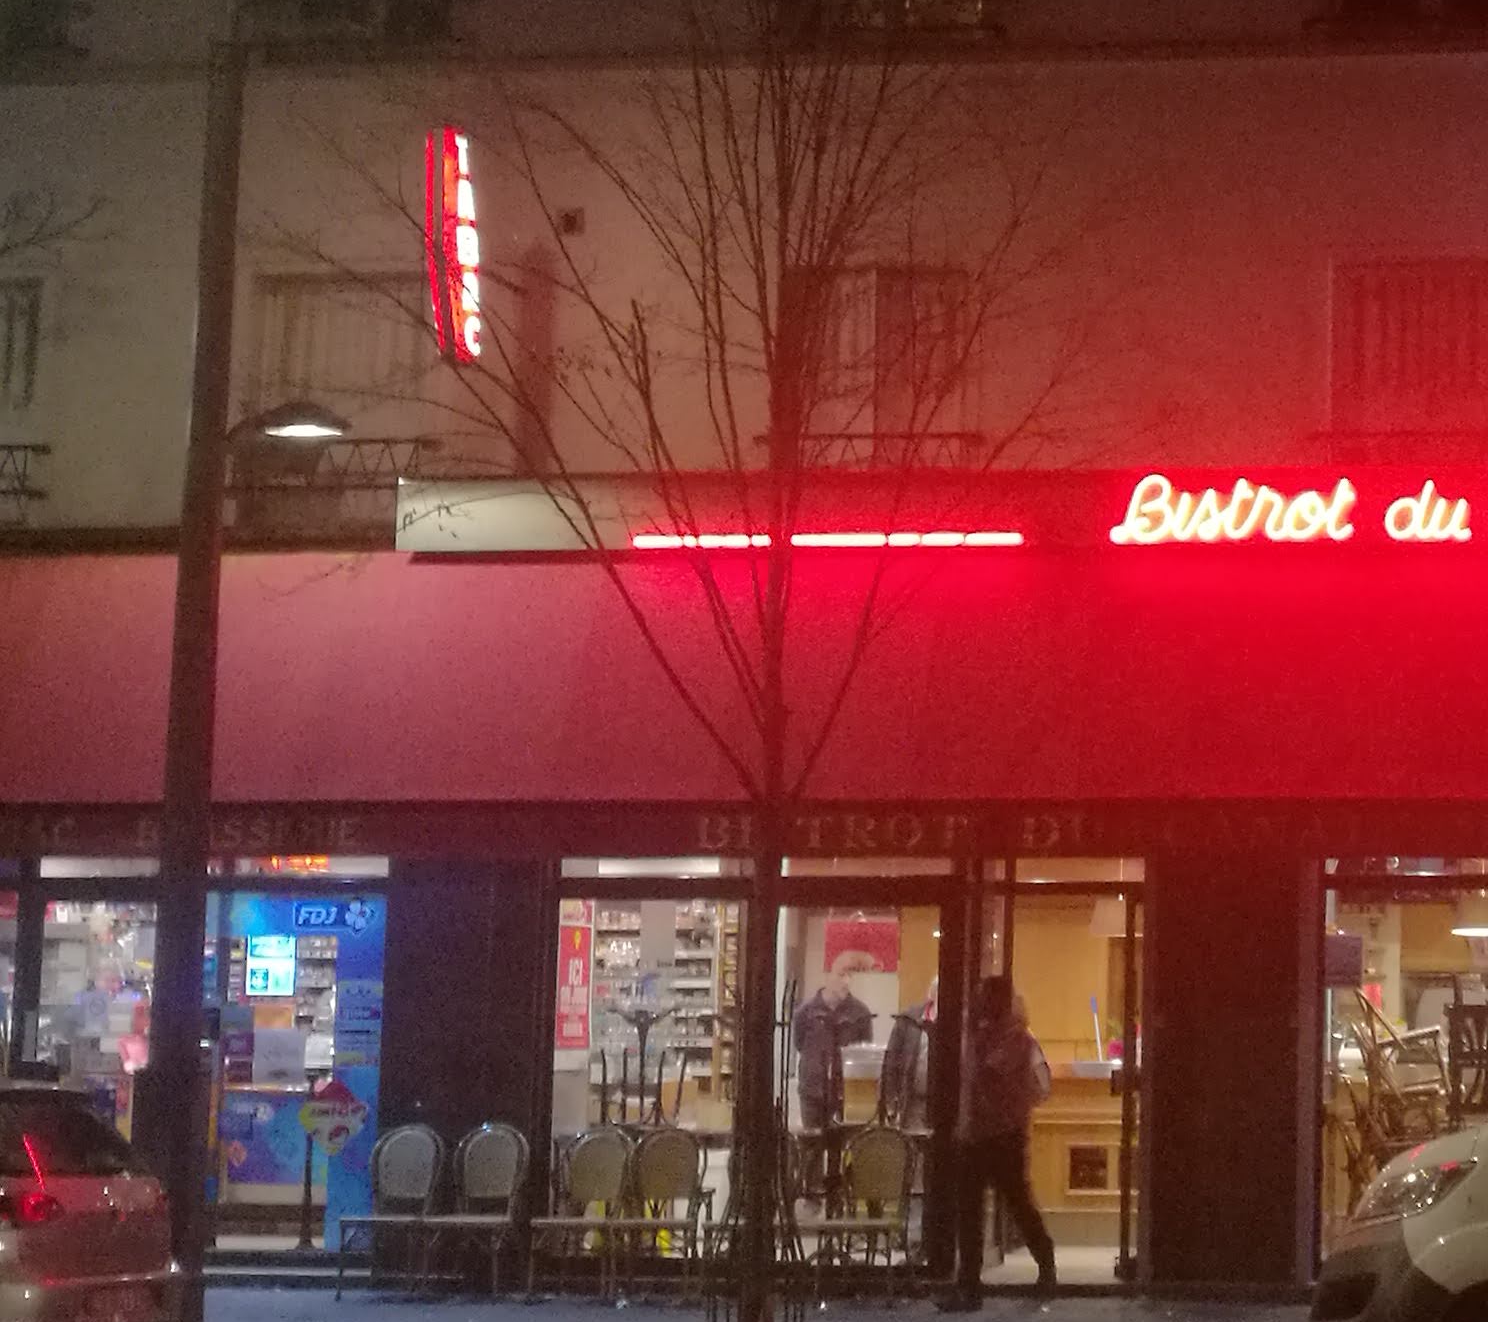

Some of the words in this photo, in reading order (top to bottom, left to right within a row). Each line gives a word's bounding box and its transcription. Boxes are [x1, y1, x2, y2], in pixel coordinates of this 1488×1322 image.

[454, 134, 482, 357] TABAC
[1108, 473, 1357, 545] Bistrot
[1383, 478, 1473, 543] du
[699, 813, 977, 850] BITROT
[298, 906, 338, 925] FDJ
